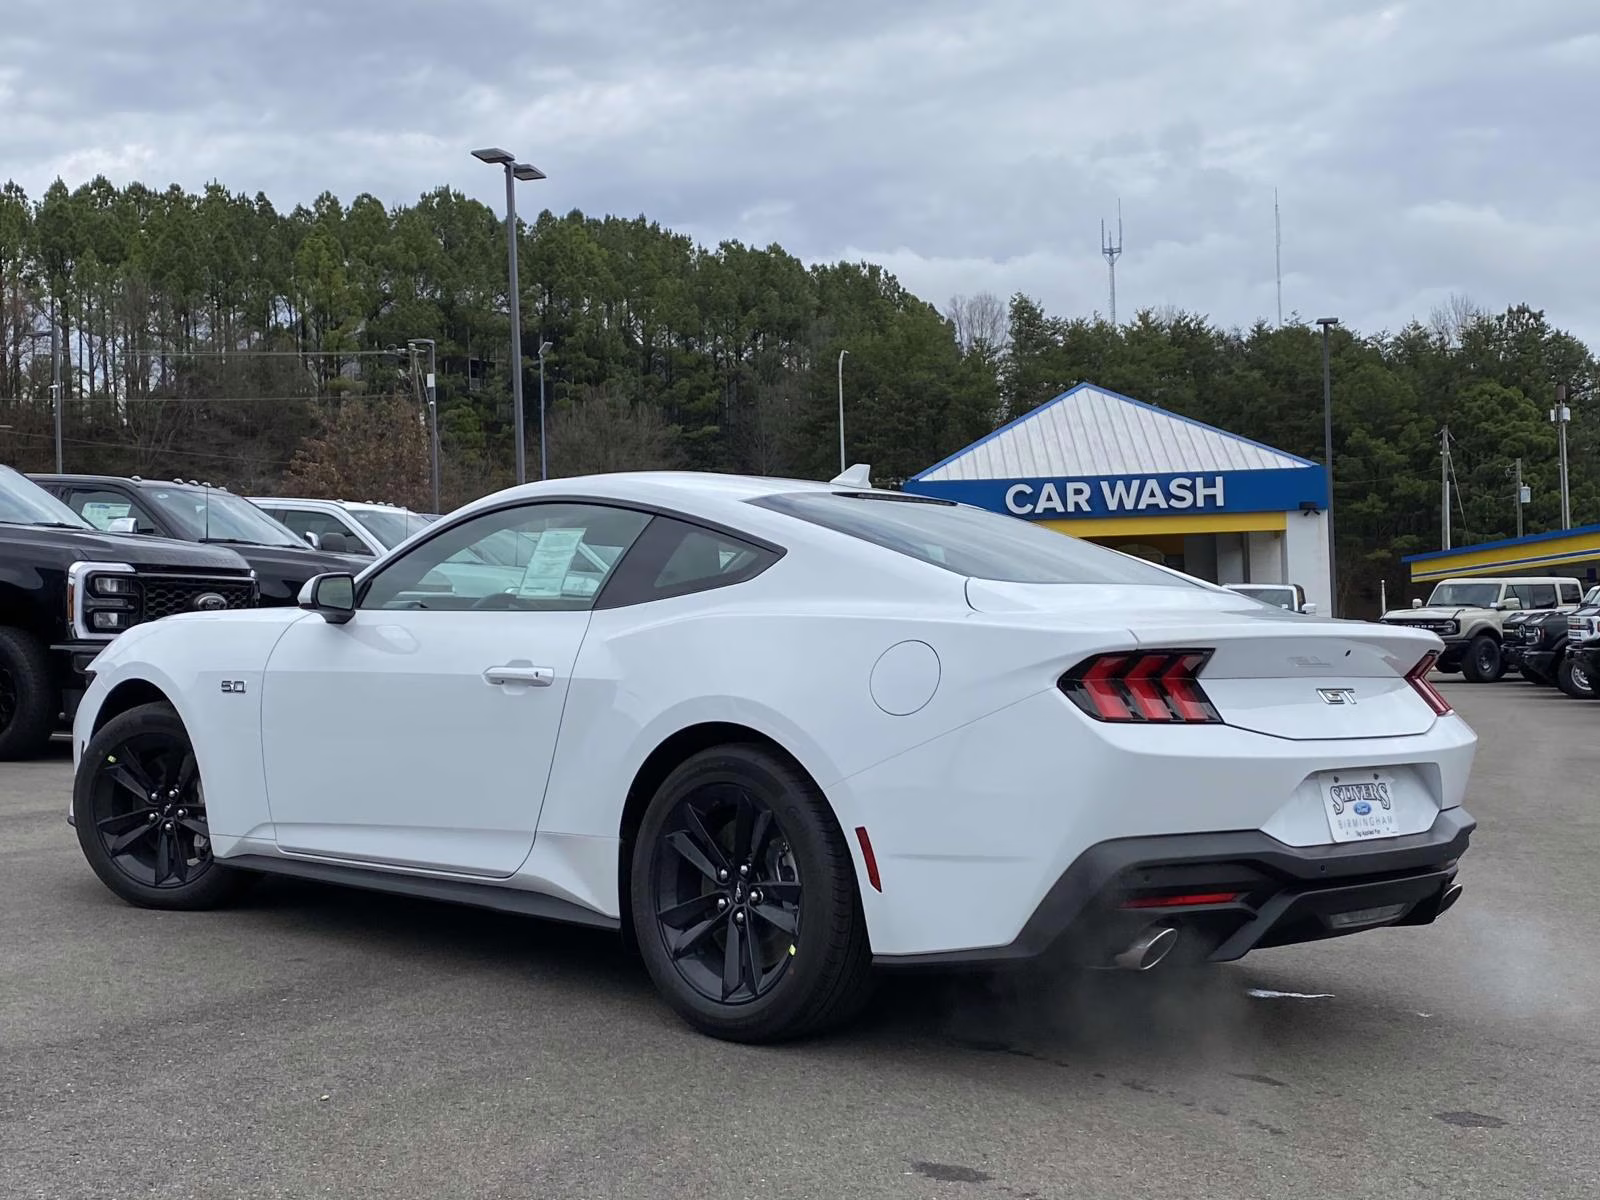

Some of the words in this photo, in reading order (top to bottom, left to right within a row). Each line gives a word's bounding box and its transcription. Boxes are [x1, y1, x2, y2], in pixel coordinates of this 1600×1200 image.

[1005, 482, 1092, 515] CAR
[1100, 476, 1225, 511] WASH
[1315, 687, 1357, 705] GT
[1337, 815, 1393, 830] BIRMINGHAM
